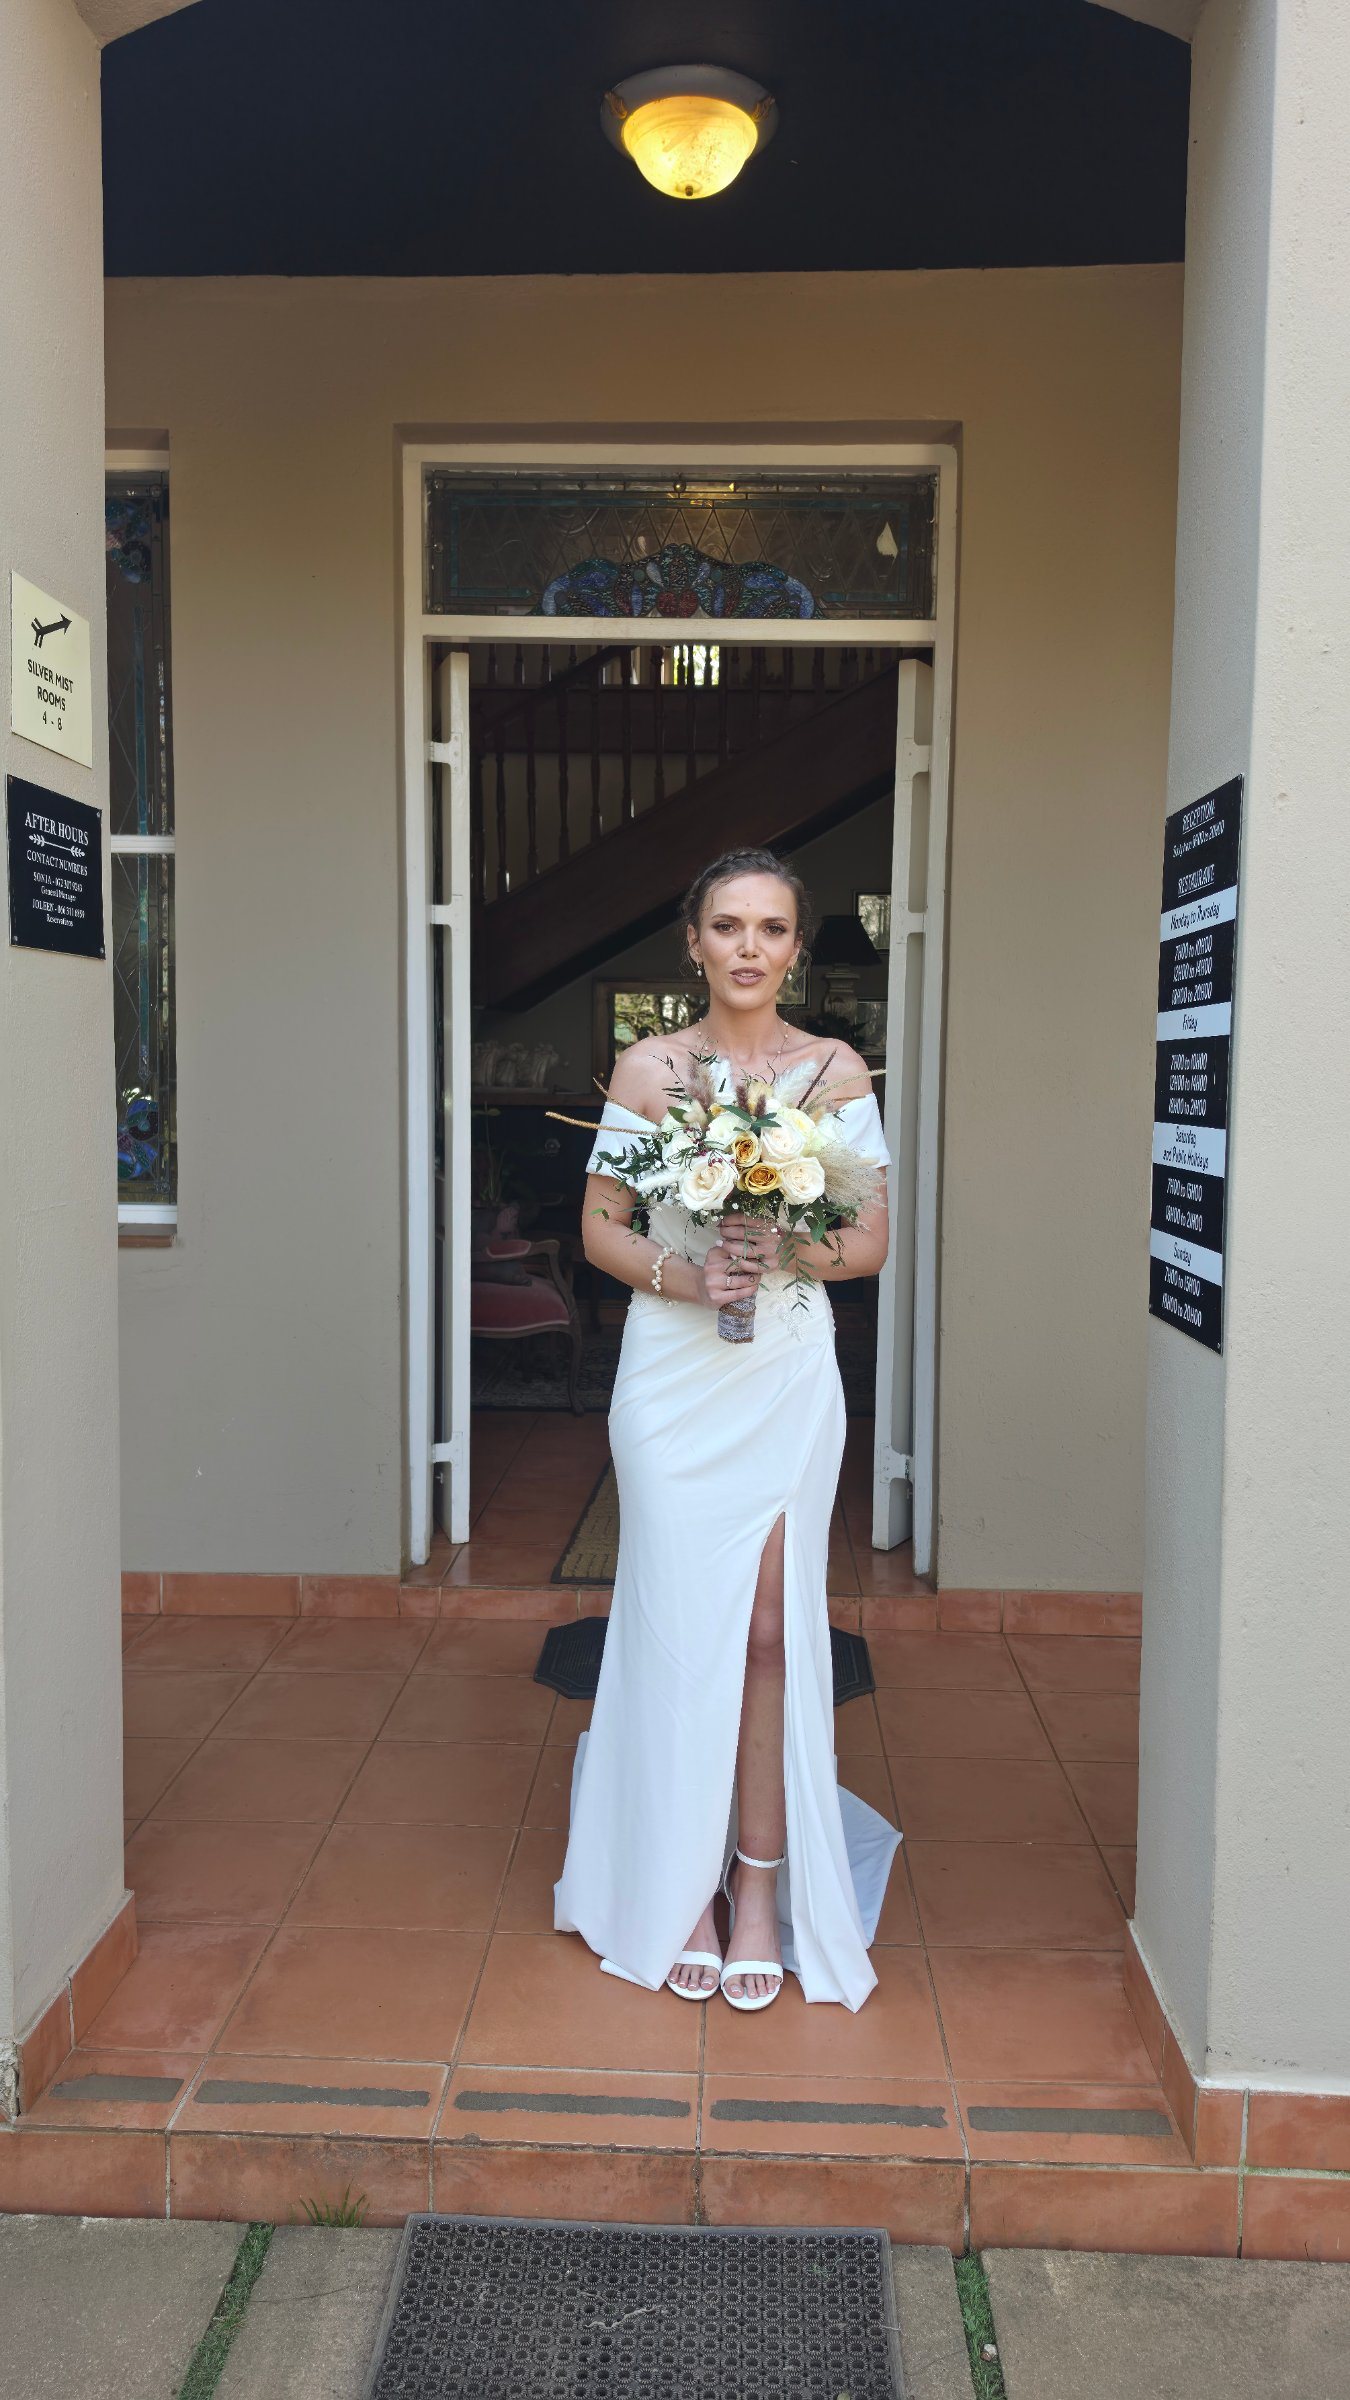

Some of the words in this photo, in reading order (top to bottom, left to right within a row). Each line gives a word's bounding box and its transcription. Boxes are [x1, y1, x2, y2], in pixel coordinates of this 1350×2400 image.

[28, 659, 54, 684] SILVER
[56, 673, 73, 693] MIST
[38, 686, 65, 711] ROOMS
[42, 711, 47, 724] 4
[58, 717, 62, 731] 8
[1182, 799, 1215, 832] RECEPTION
[24, 812, 56, 835] AFTER
[58, 822, 88, 846] HOURS
[26, 850, 58, 868] CONTACT
[59, 858, 88, 876] NUMBERS
[1178, 864, 1215, 894] RESTAURANT
[41, 886, 58, 897] General
[59, 890, 76, 902] Manager
[46, 914, 73, 927] Reservations
[1170, 914, 1189, 931] Monday
[1190, 911, 1197, 924] to
[1197, 902, 1220, 922] Thursday
[1189, 945, 1194, 957] to
[1189, 966, 1194, 978] to
[1188, 991, 1193, 1002] to
[1183, 1014, 1198, 1032] Friday
[1184, 1056, 1189, 1070] to
[1185, 1077, 1190, 1091] to
[1184, 1102, 1189, 1115] to
[1176, 1126, 1196, 1148] Saturday
[1163, 1148, 1172, 1161] and
[1172, 1146, 1186, 1164] Public
[1187, 1150, 1209, 1171] Holidays
[1180, 1184, 1186, 1197] to
[1181, 1212, 1186, 1226] to
[1174, 1242, 1192, 1266] Sunday
[1178, 1274, 1184, 1288] to
[1178, 1305, 1184, 1317] to
